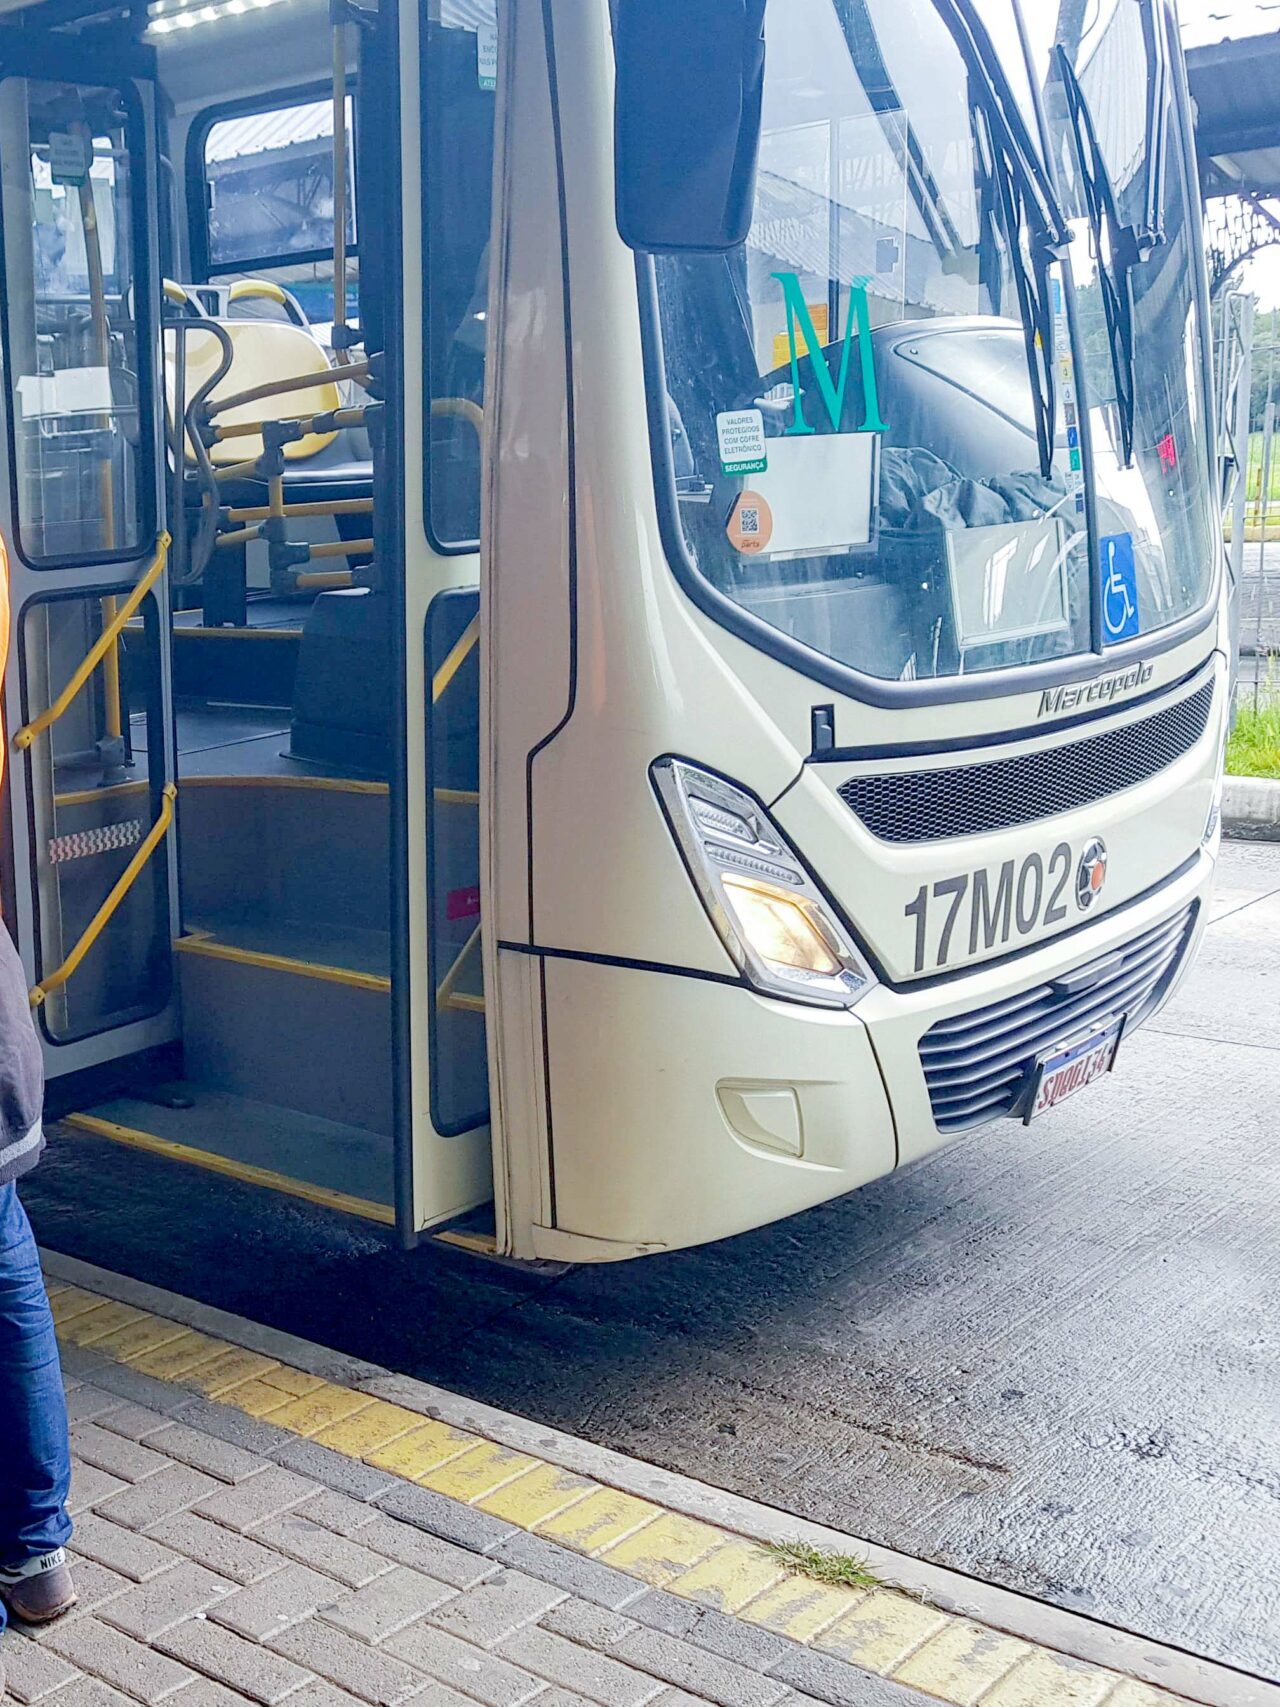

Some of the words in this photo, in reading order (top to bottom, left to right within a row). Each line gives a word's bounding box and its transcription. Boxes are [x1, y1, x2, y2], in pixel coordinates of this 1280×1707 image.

[770, 272, 891, 434] M
[726, 416, 754, 425] VALORES
[721, 425, 761, 435] PROTEGIDOS
[724, 437, 738, 445] COM
[740, 435, 760, 443] COFRE
[724, 444, 762, 455] ELETRÔNICO
[724, 461, 765, 472] SEGURANÇA
[1037, 660, 1154, 718] Marcopolo
[904, 841, 1072, 973] 17M02
[39, 1551, 62, 1570] NIKE
